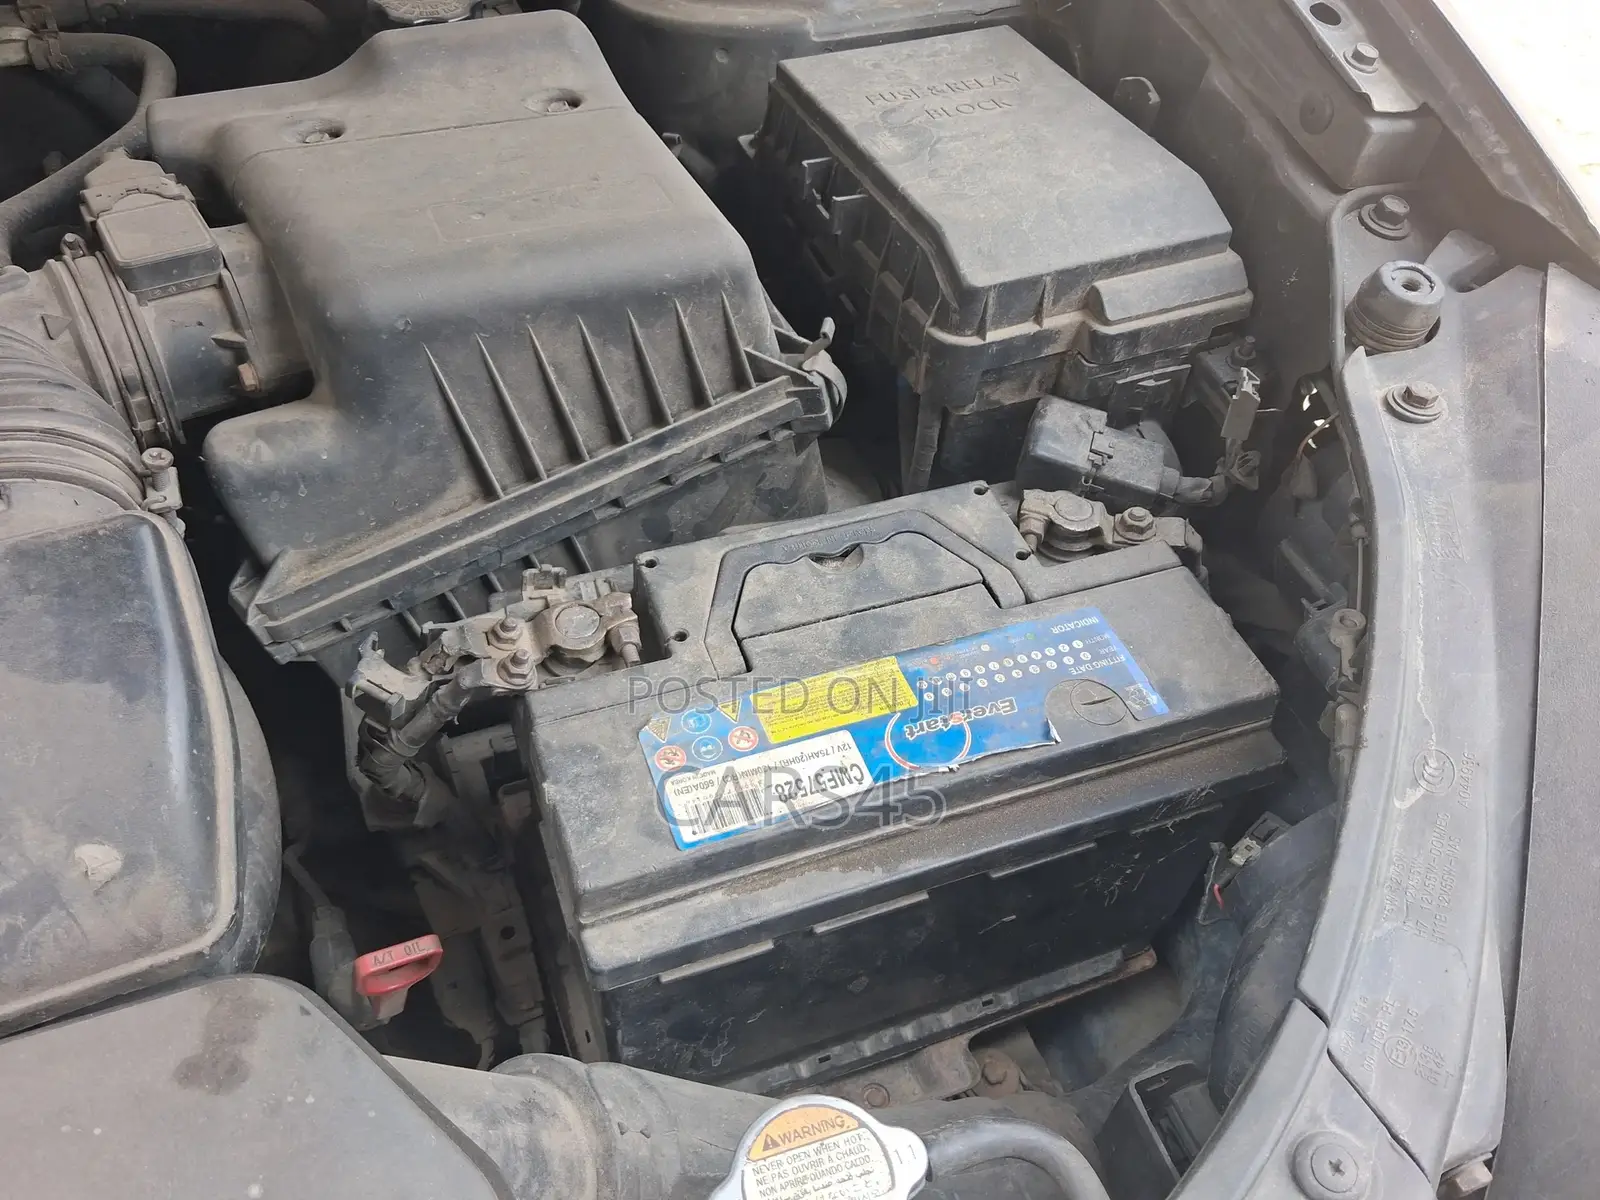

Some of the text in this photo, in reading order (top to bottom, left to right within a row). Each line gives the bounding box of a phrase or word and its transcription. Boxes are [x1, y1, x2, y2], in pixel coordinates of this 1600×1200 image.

[923, 98, 1013, 119] BLOCK
[1050, 616, 1100, 634] INDICATOR
[1068, 655, 1126, 676] FITTING DATE
[903, 697, 1019, 740] Everstart
[836, 743, 853, 755] 12V
[773, 763, 865, 804] CMF57528
[1413, 919, 1429, 939] H7
[372, 941, 426, 966] A/T OIL
[751, 1159, 785, 1176] NEVER
[785, 1150, 811, 1165] OPEN
[812, 1140, 841, 1157] WHEN
[755, 1175, 771, 1187] NE
[770, 1168, 790, 1182] PAS
[791, 1157, 825, 1175] OUVRIR
[759, 1184, 778, 1198] NON
[778, 1174, 810, 1193] APRIRE
[809, 1163, 844, 1182] QUANDO
